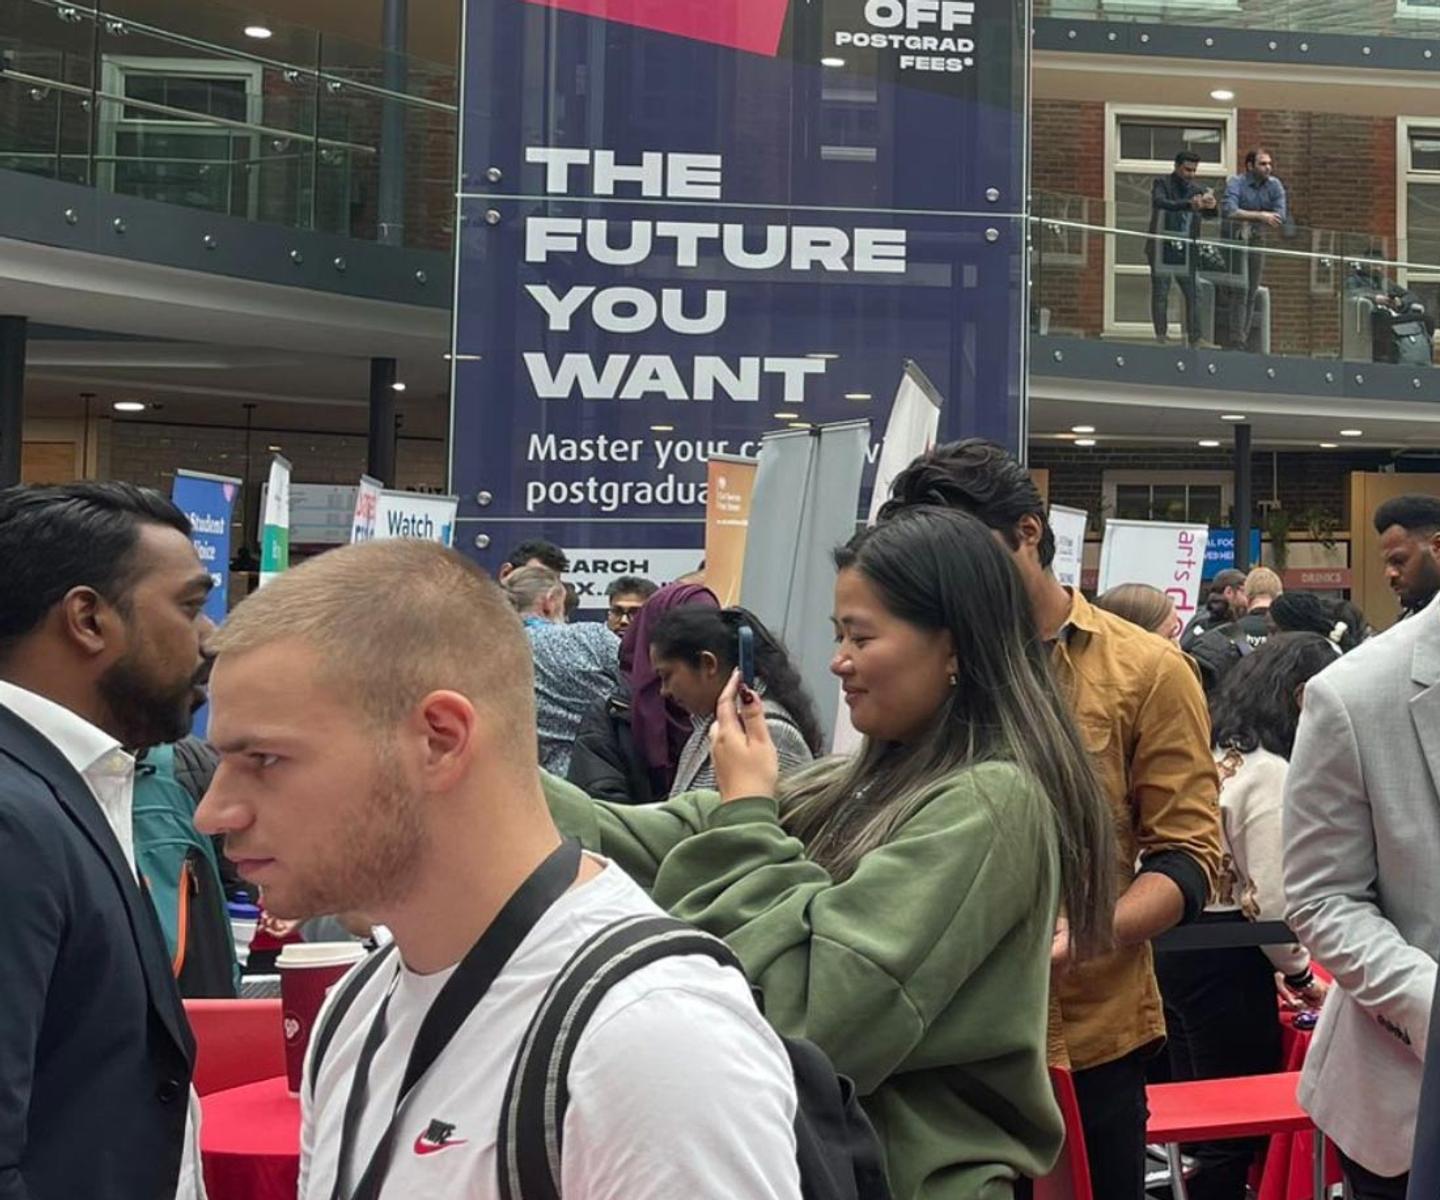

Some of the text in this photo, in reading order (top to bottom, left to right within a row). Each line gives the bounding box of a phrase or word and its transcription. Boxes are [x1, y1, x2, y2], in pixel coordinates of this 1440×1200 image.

[864, 0, 975, 31] OFF
[834, 31, 975, 53] POSTGRAD
[525, 146, 722, 199] THE
[525, 217, 907, 273] FUTURE
[524, 284, 727, 335] YOU
[522, 352, 826, 402] WANT
[528, 434, 643, 462] Master
[654, 440, 726, 469] your
[527, 474, 709, 511] postgradua
[387, 509, 434, 540] Watch
[559, 559, 650, 574] EARCH
[1174, 531, 1196, 582] arts
[423, 1118, 457, 1145] NIKE
